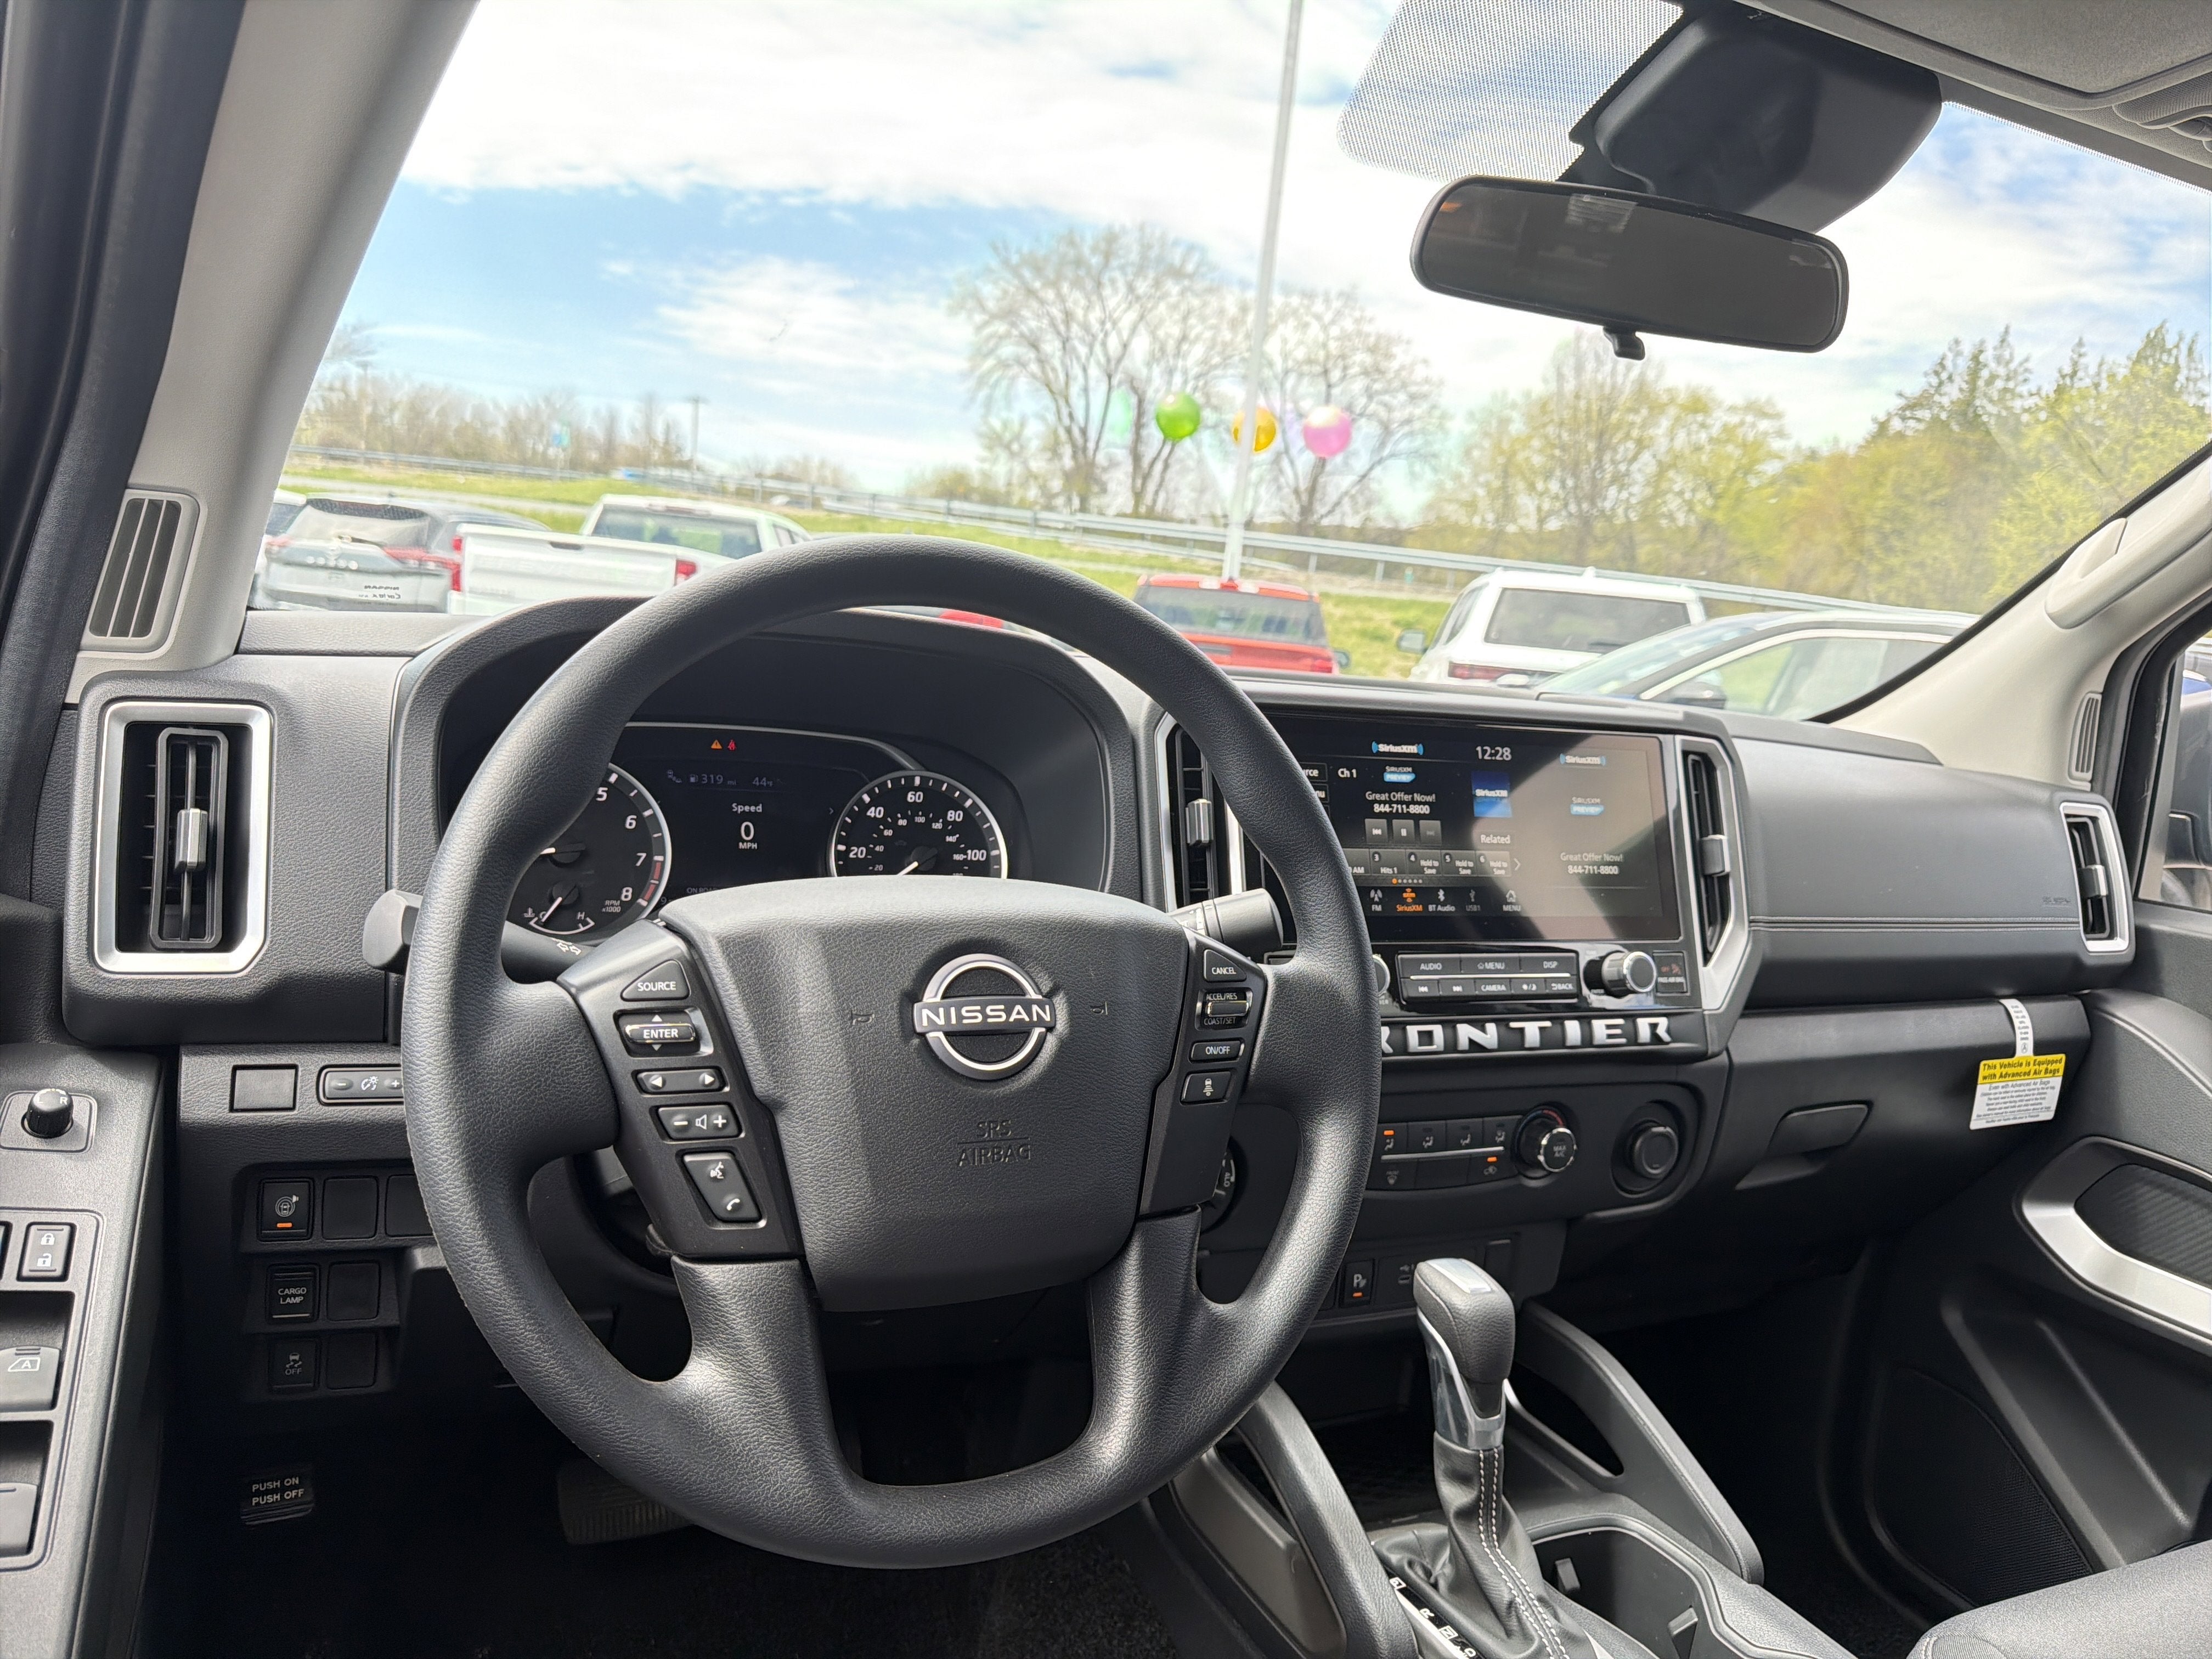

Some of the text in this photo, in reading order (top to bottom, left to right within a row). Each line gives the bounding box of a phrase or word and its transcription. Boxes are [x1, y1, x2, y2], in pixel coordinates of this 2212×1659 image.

[1476, 746, 1511, 760] 12:28
[1338, 768, 1357, 778] Ch 1
[701, 774, 723, 784] 319
[595, 787, 608, 802] 5
[907, 791, 923, 803] 60
[1365, 791, 1436, 802] Great Offer Now!
[732, 803, 762, 814] Speed
[866, 806, 884, 818] 40
[1373, 803, 1430, 814] 844-711-8800
[947, 810, 963, 821] 80
[625, 815, 637, 829] 6
[741, 821, 754, 840] 0
[1481, 834, 1511, 844] Related
[849, 847, 866, 858] 20
[966, 850, 986, 861] 100
[1560, 852, 1582, 861] Great
[1583, 853, 1602, 862] Offer
[635, 853, 647, 866] 7
[1567, 865, 1618, 874] 844-711-8800
[620, 887, 633, 901] 8
[577, 911, 585, 919] H
[1211, 967, 1237, 975] CANCEL
[1485, 962, 1505, 970] MENU
[637, 980, 676, 992] SOURCE
[1206, 992, 1238, 1001] ACCEL/RES
[922, 1004, 1051, 1026] NISSAN
[1204, 1017, 1236, 1025] COAST/SET
[642, 1028, 679, 1039] ENTER
[1205, 1046, 1231, 1055] ON/OFF
[1983, 1063, 1997, 1071] This
[1999, 1060, 2023, 1069] Vehicle
[2033, 1057, 2063, 1067] Equipped
[1982, 1073, 1997, 1081] with
[1998, 1070, 2031, 1080] Advanced
[2044, 1067, 2061, 1076] Bags
[60, 1096, 67, 1105] R
[977, 1119, 1012, 1138] SRS
[958, 1143, 1031, 1167] AIRBAG
[278, 1287, 307, 1295] CARGO
[280, 1296, 304, 1304] LAMP
[252, 1476, 299, 1493] PUSH ON
[252, 1488, 304, 1506] PUSH OFF
[1419, 1608, 1435, 1618] R
[1464, 1647, 1476, 1657] D
